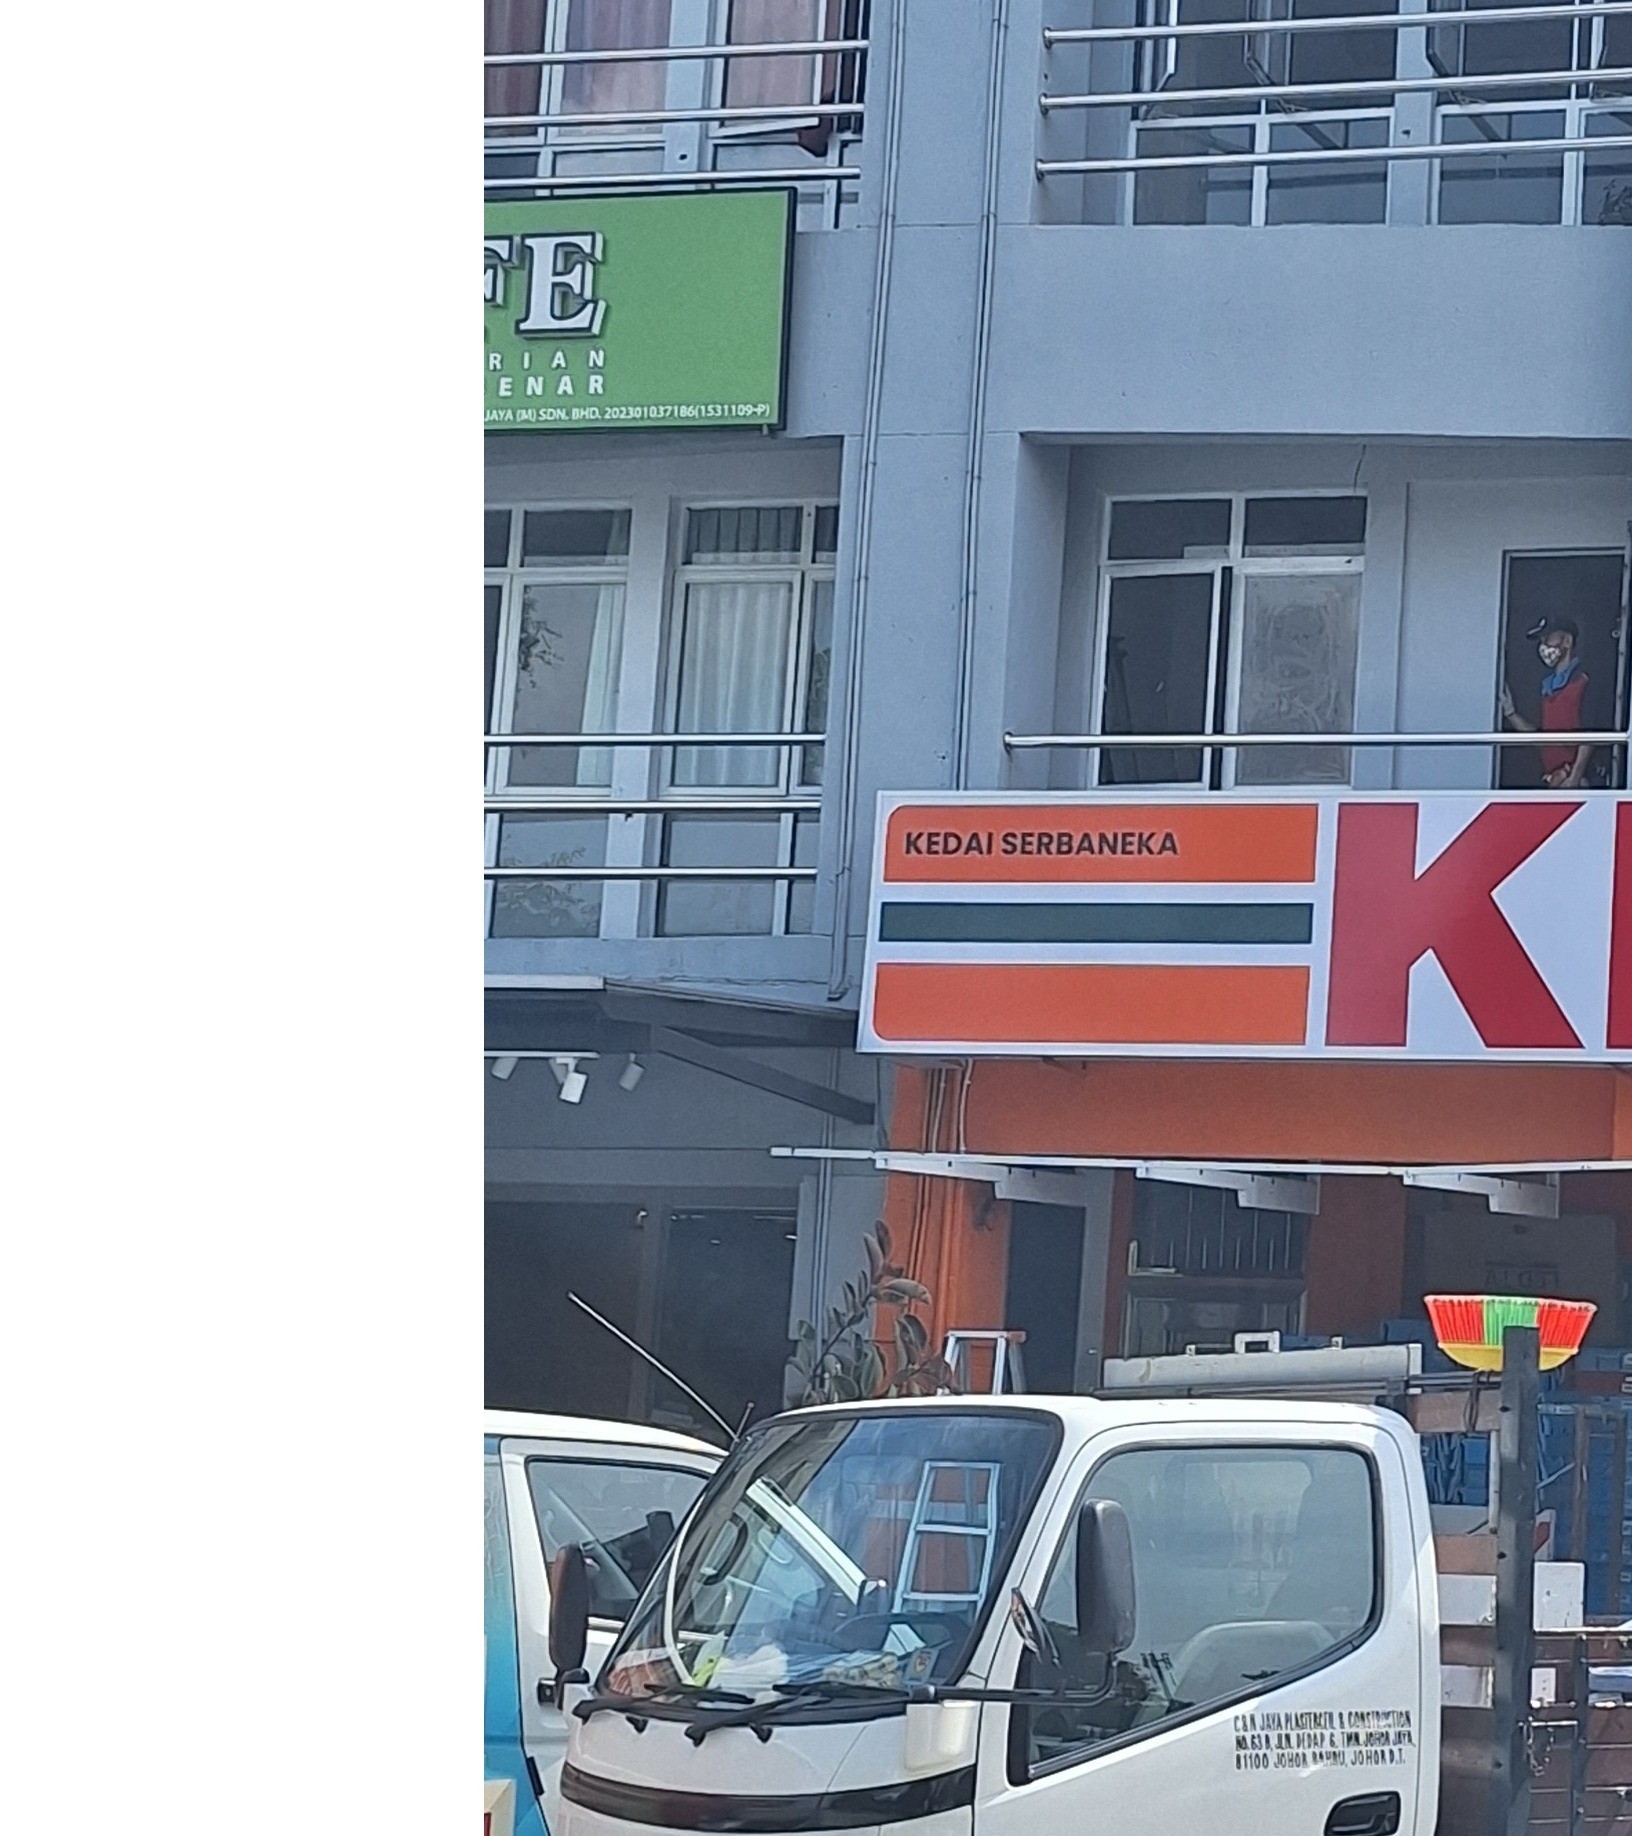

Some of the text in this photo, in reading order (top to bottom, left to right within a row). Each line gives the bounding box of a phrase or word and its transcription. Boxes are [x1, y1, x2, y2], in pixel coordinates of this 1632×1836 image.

[538, 408, 569, 420] SDN.
[571, 407, 601, 420] BHD.
[905, 832, 1179, 855] KEDAI SERBANEKA
[1236, 1753, 1269, 1770] 81100
[1273, 1751, 1308, 1768] JOHOR
[1351, 1749, 1386, 1766] JOHOR
